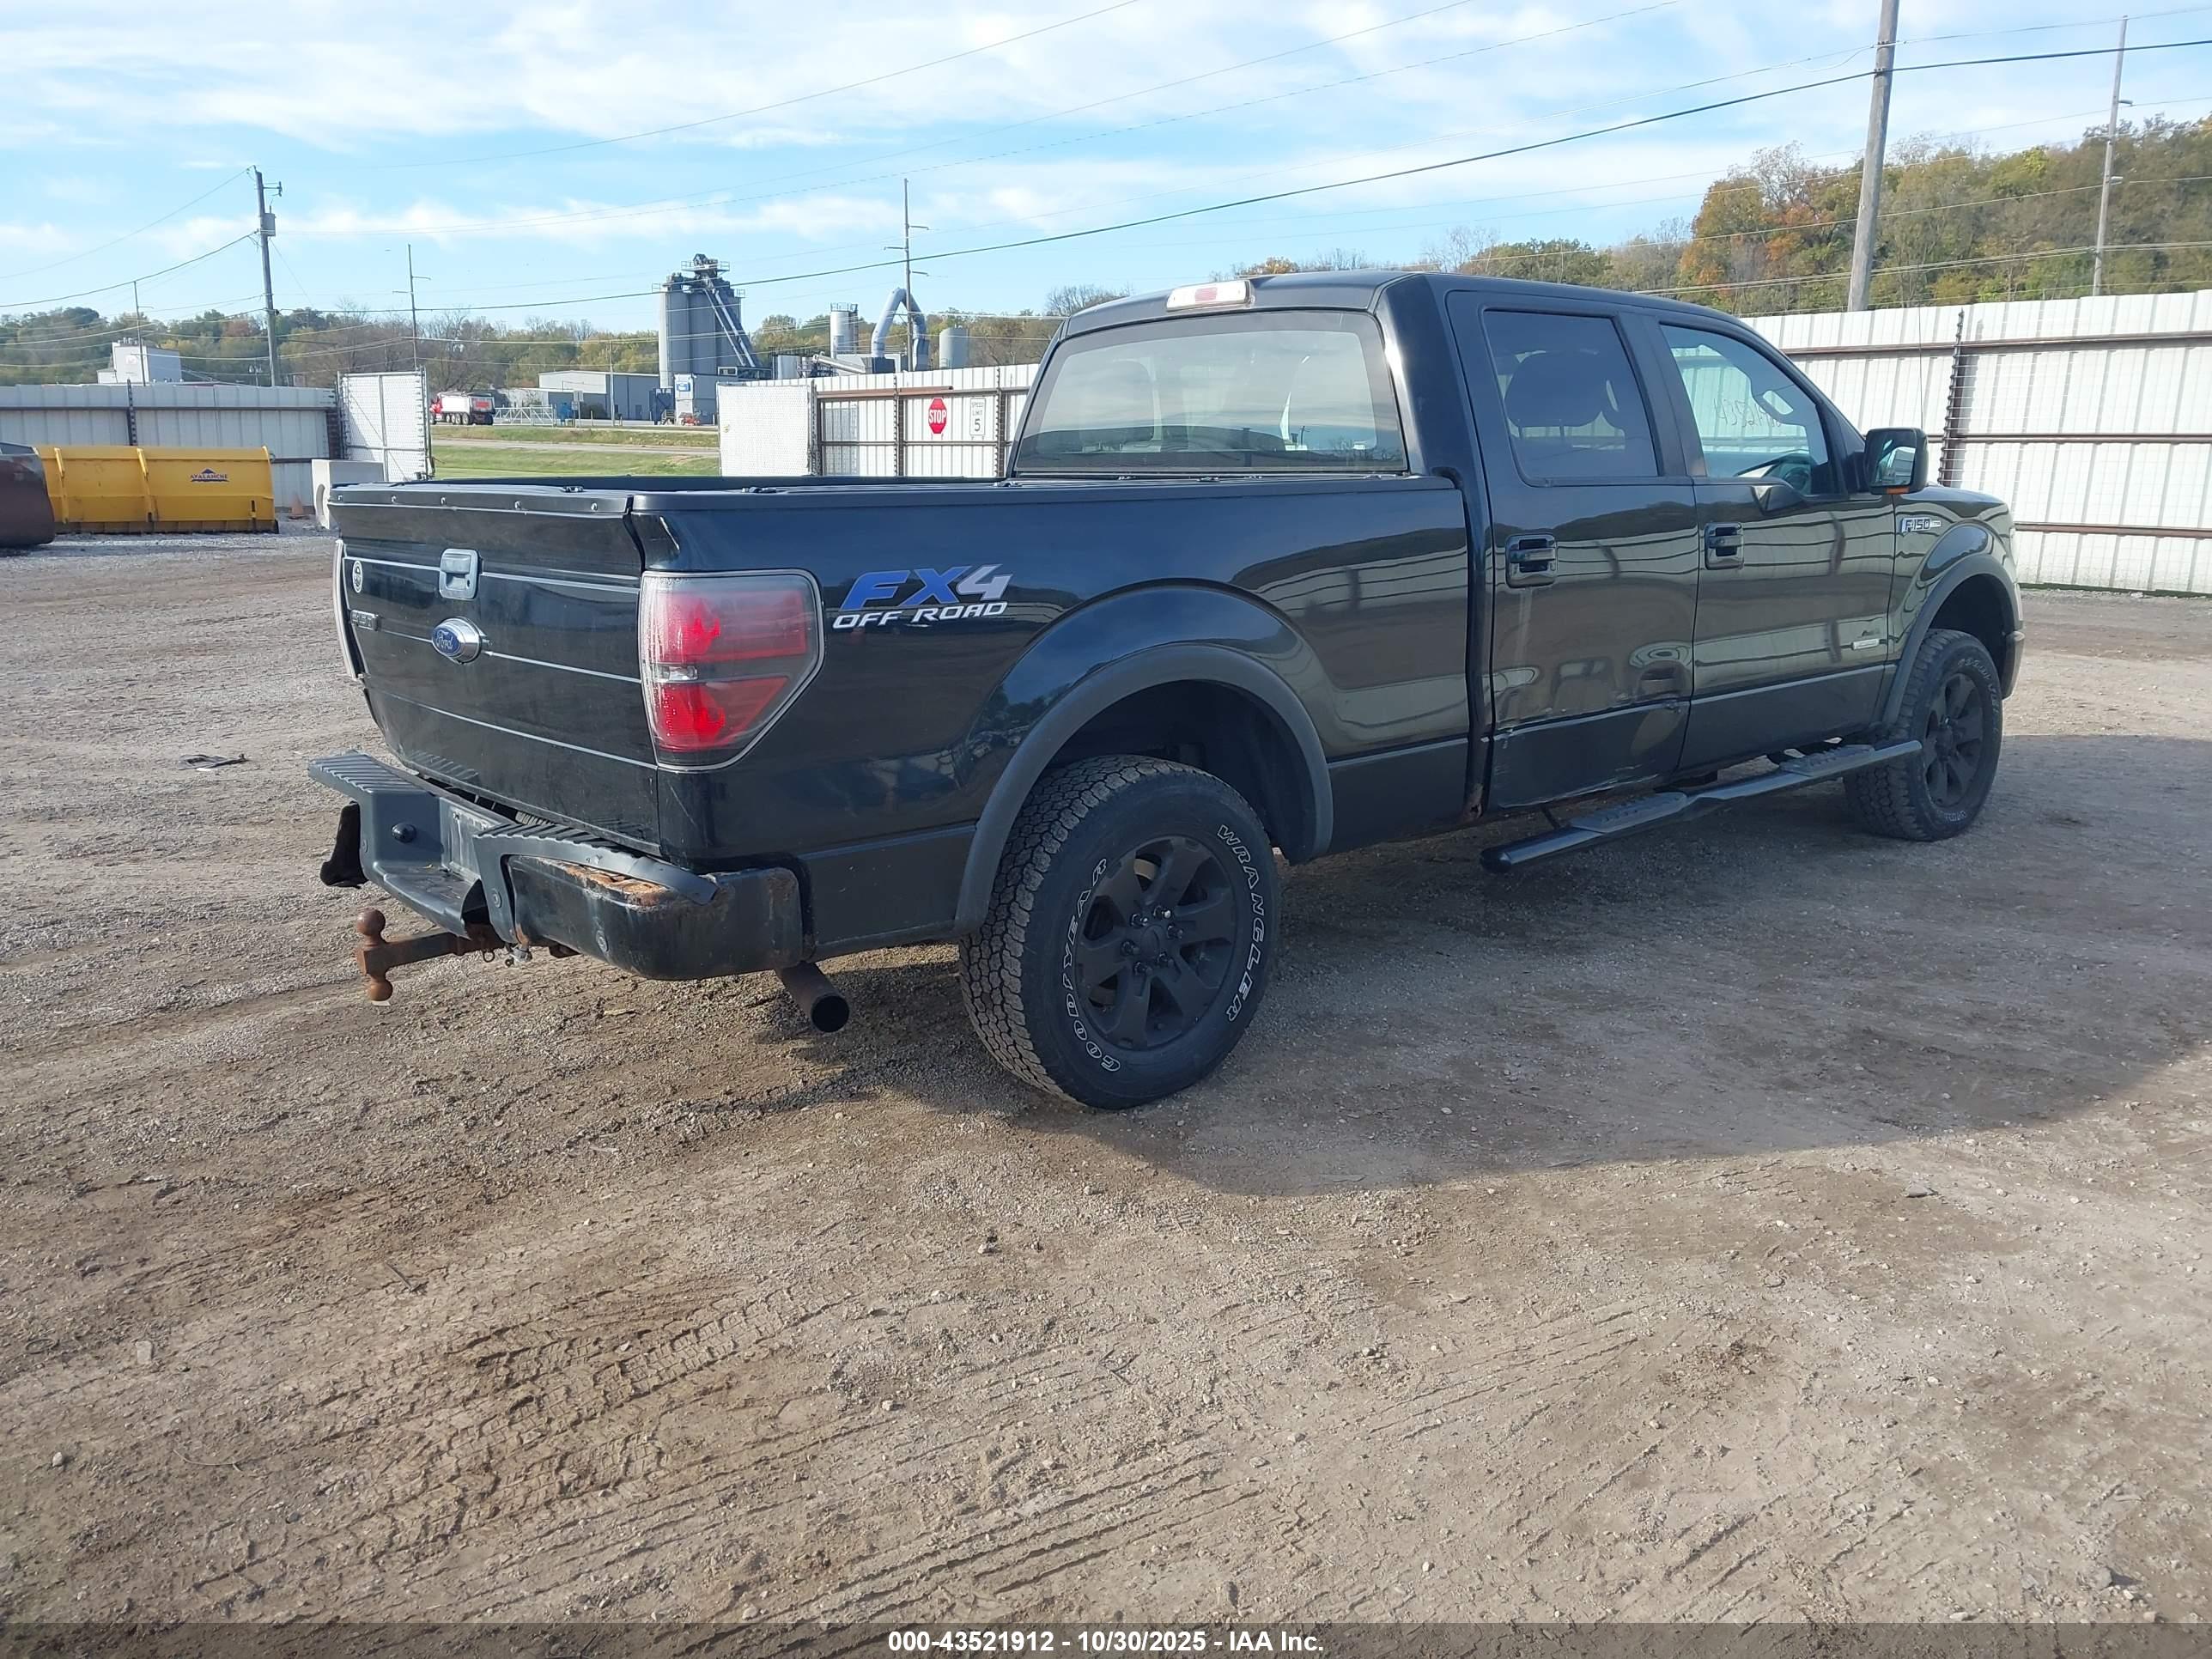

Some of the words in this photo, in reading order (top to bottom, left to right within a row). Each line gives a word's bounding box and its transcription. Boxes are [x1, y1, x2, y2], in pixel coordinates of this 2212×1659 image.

[928, 409, 947, 424] STOP
[974, 418, 981, 432] 5
[838, 563, 1013, 612] FX4
[832, 610, 904, 629] OFF
[910, 602, 1008, 623] ROAD
[1217, 824, 1265, 1022] WRANGLER
